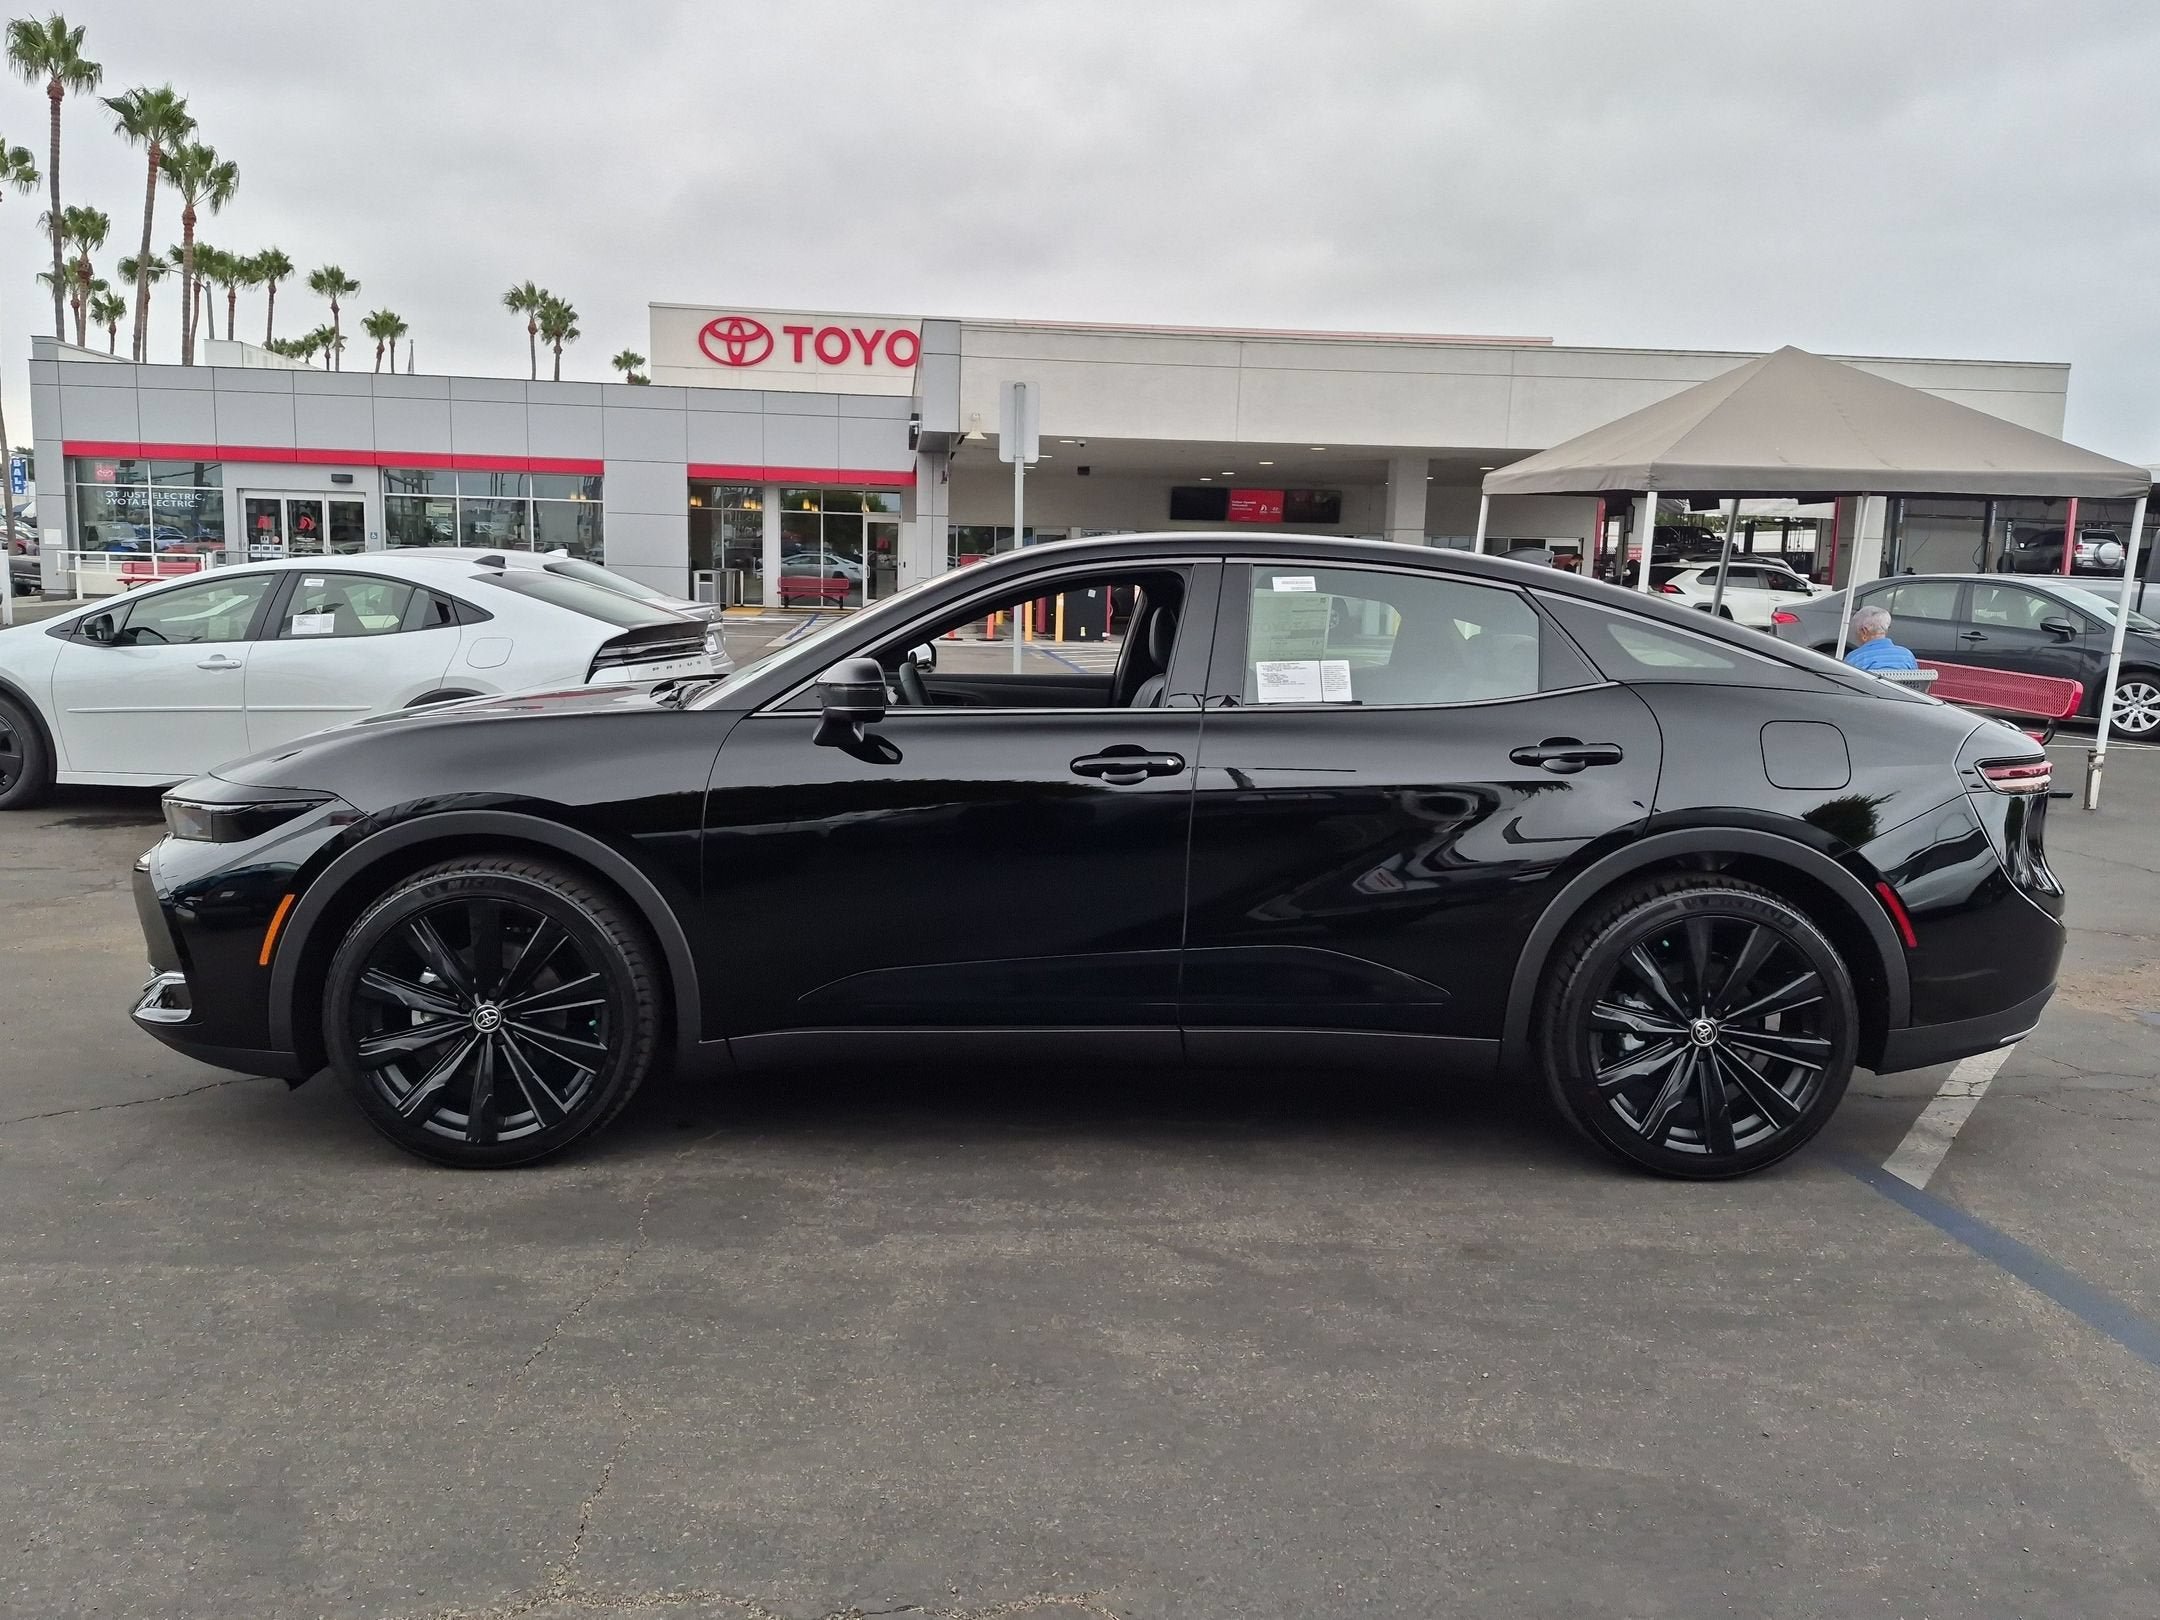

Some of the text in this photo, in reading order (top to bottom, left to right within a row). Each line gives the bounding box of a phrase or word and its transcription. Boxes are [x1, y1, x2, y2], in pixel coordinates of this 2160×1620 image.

[13, 459, 22, 494] BALL
[122, 491, 147, 499] JUST
[153, 492, 206, 501] ELECTRIC,
